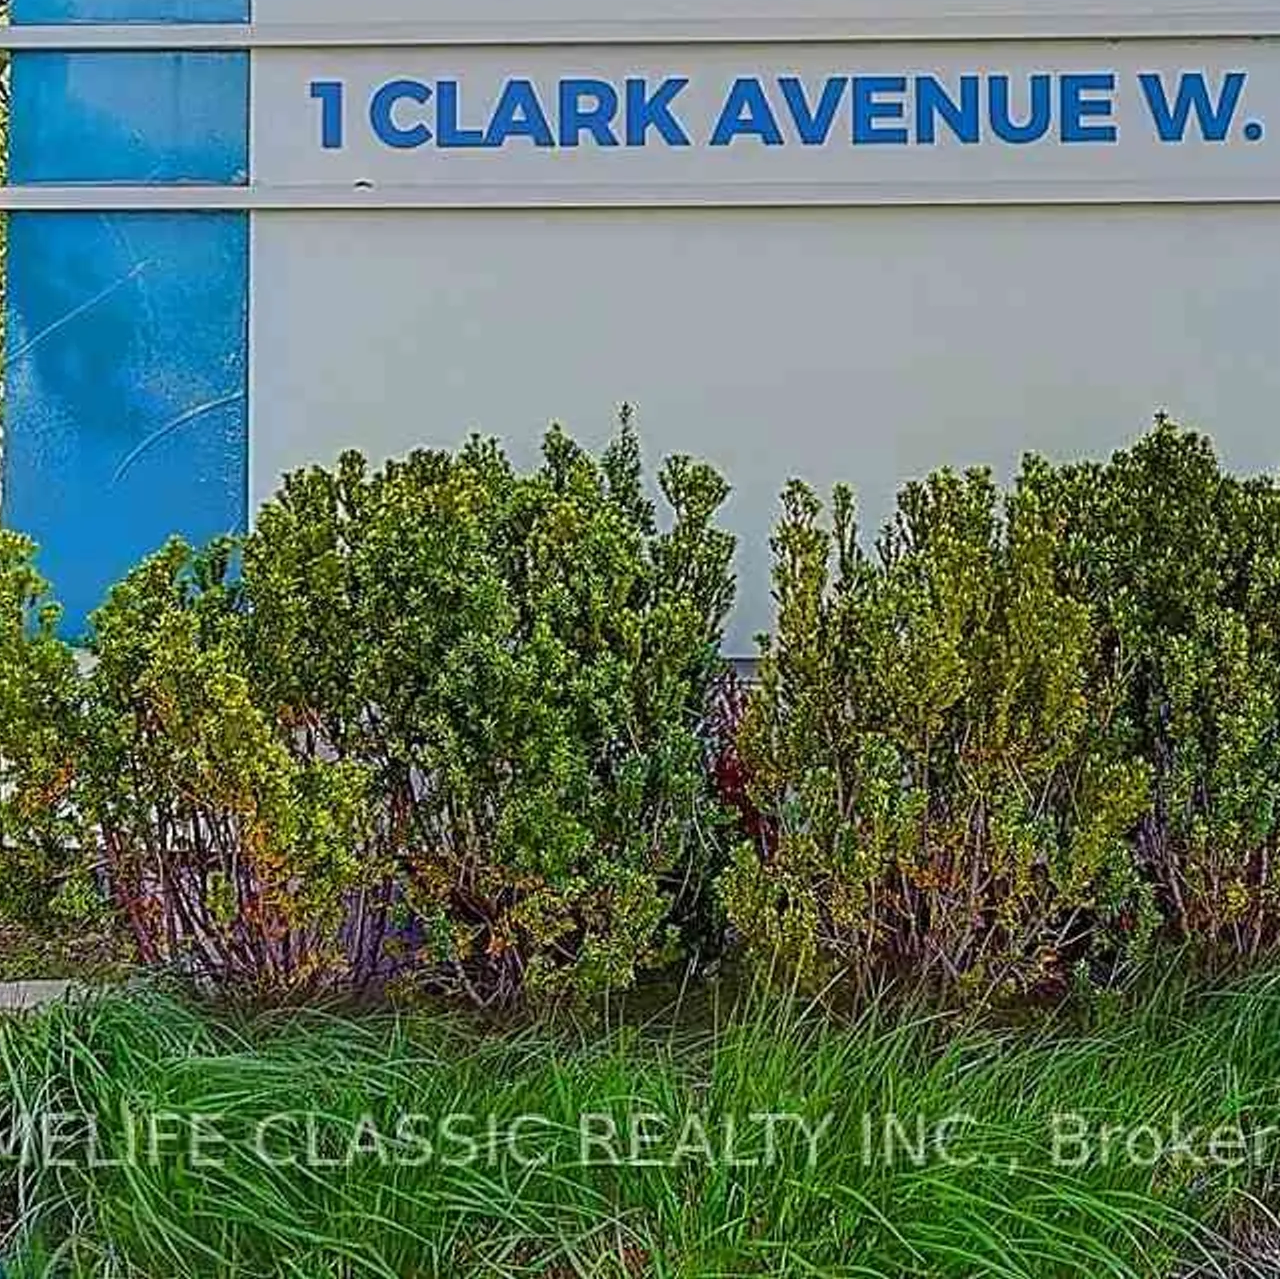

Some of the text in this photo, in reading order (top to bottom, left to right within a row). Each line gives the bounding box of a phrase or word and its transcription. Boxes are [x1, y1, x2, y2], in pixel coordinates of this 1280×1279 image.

[310, 72, 1264, 149] 1 CLARK AVENUE W.
